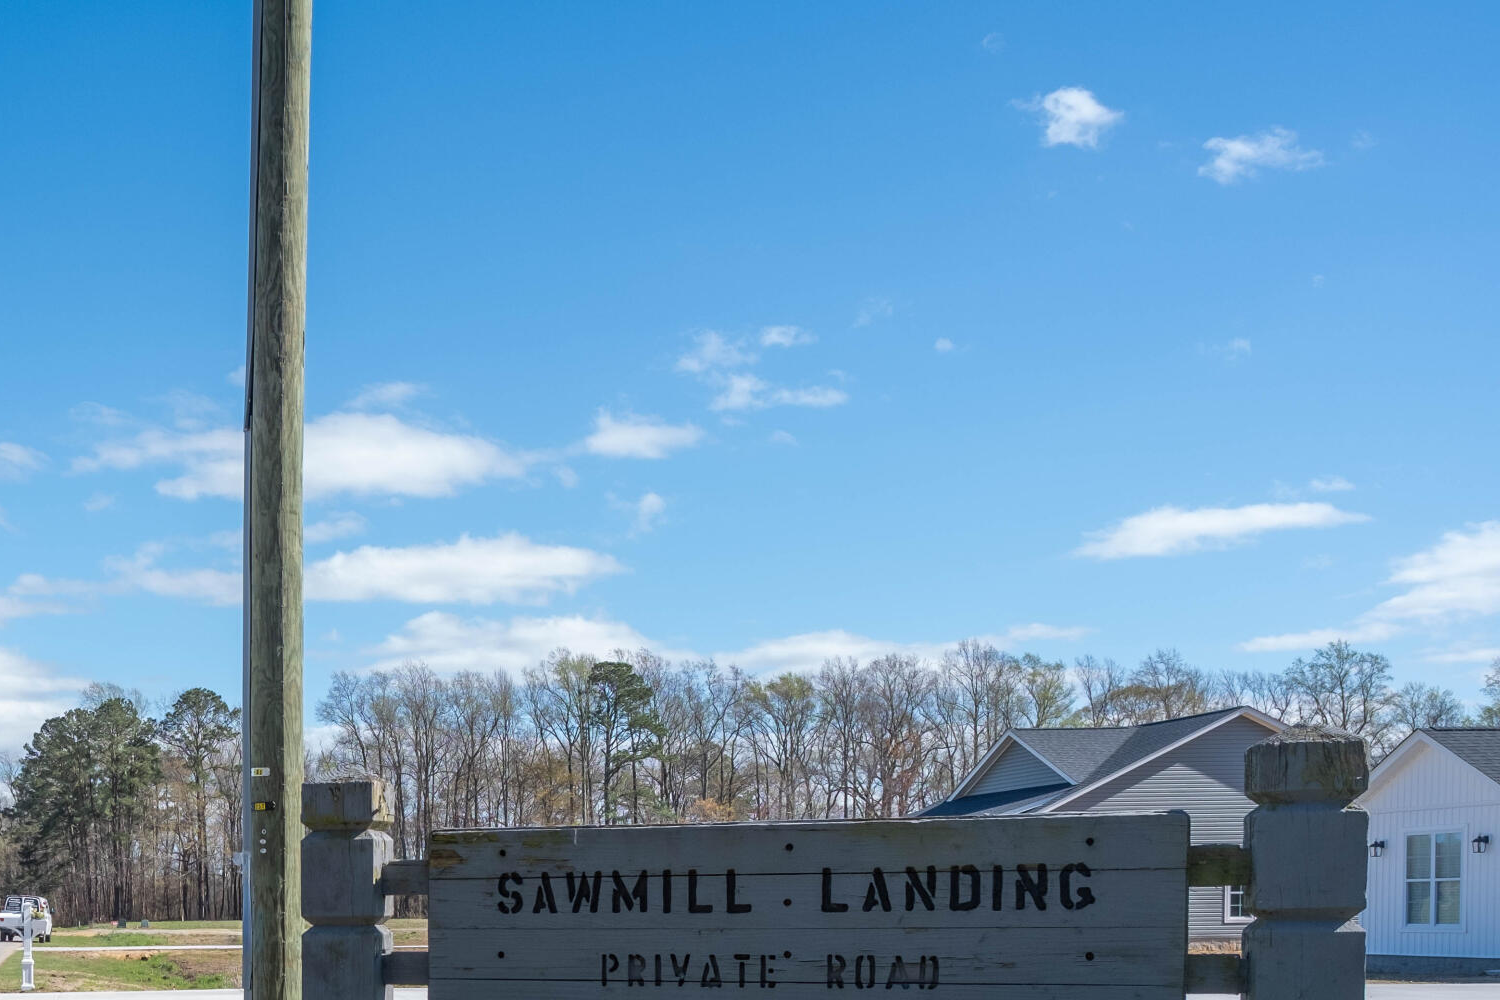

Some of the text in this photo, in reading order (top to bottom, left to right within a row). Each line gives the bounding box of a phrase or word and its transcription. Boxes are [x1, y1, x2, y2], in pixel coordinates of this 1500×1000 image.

[497, 862, 1096, 914] SAWMILL LANDING
[601, 953, 939, 990] PRIVATE ROAD
